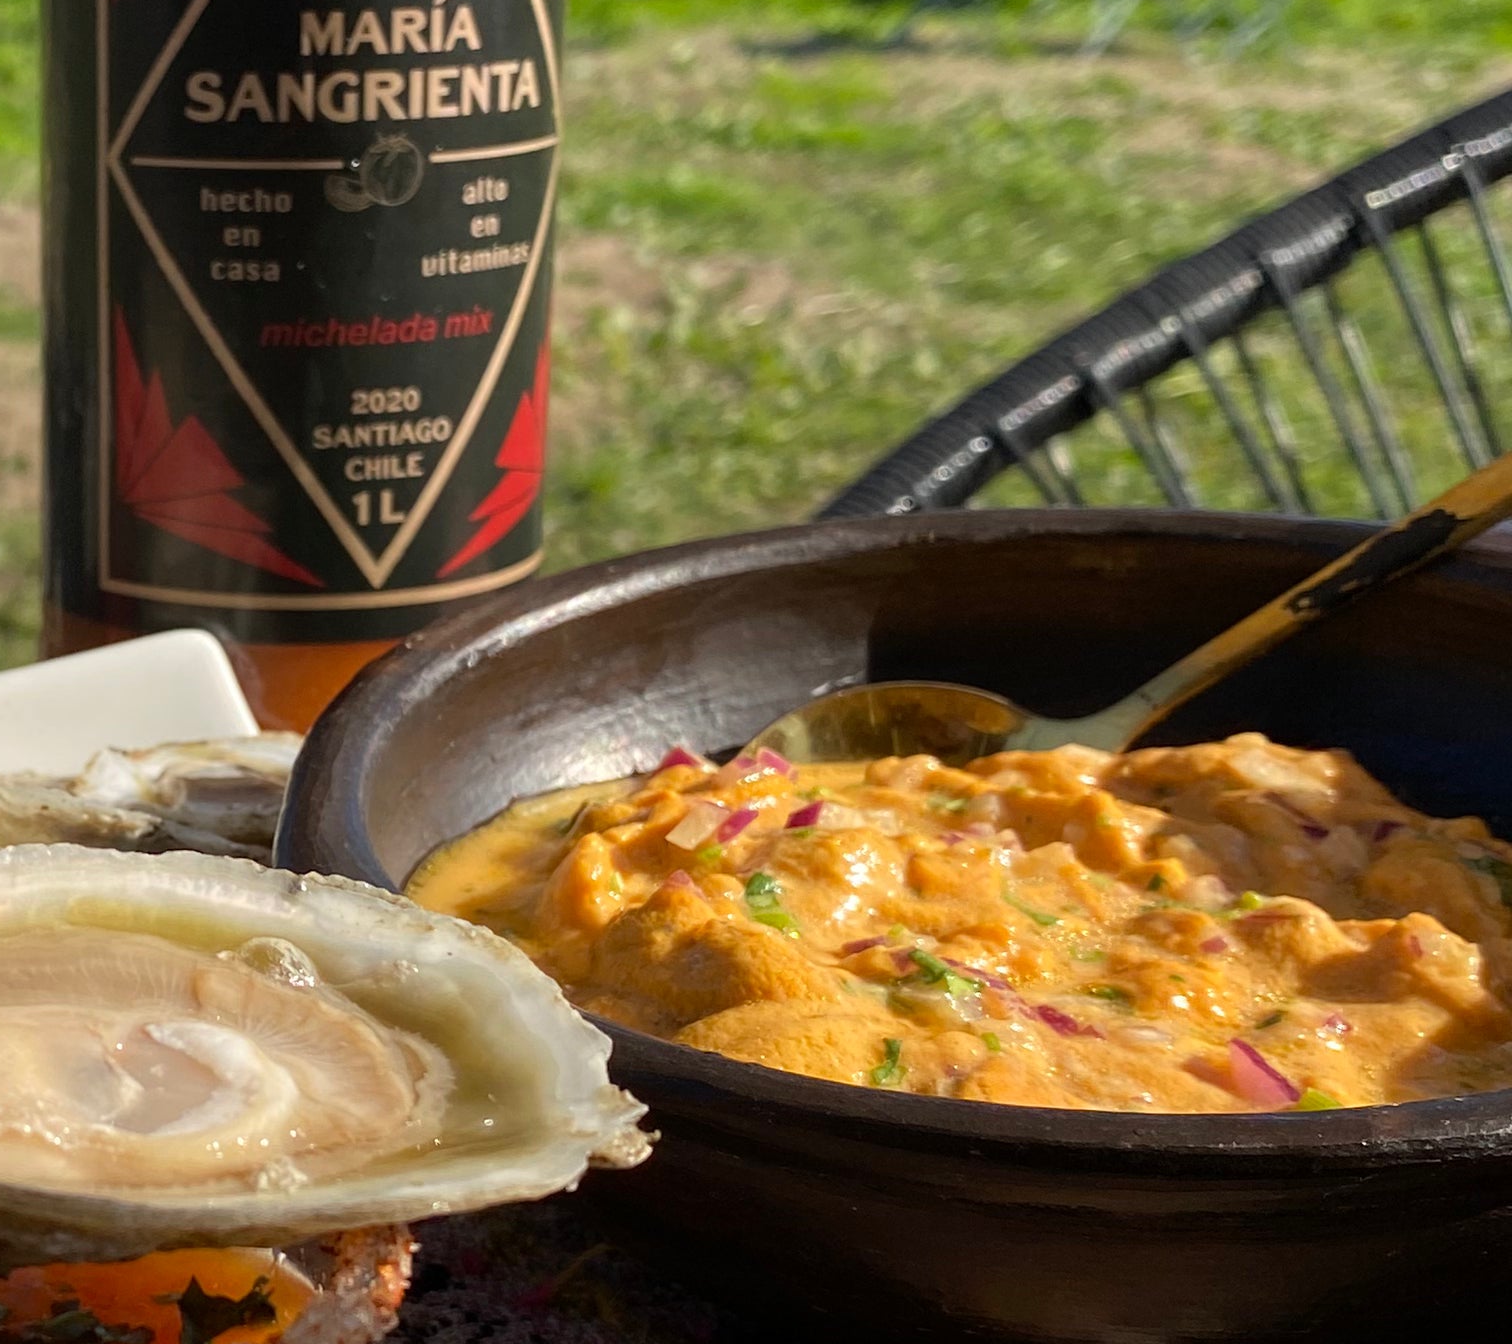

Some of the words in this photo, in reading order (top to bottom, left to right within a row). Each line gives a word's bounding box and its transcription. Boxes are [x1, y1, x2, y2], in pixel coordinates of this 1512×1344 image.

[184, 58, 541, 123] SANGRIENTA
[200, 187, 294, 213] hecho
[462, 176, 509, 205] alto
[223, 224, 261, 247] en
[470, 213, 501, 238] en
[210, 258, 280, 282] casa
[260, 314, 437, 348] michelada
[443, 305, 495, 340] mix
[350, 386, 421, 415] 2020
[313, 415, 453, 450] SANTIAGO
[344, 452, 426, 482] CHILE
